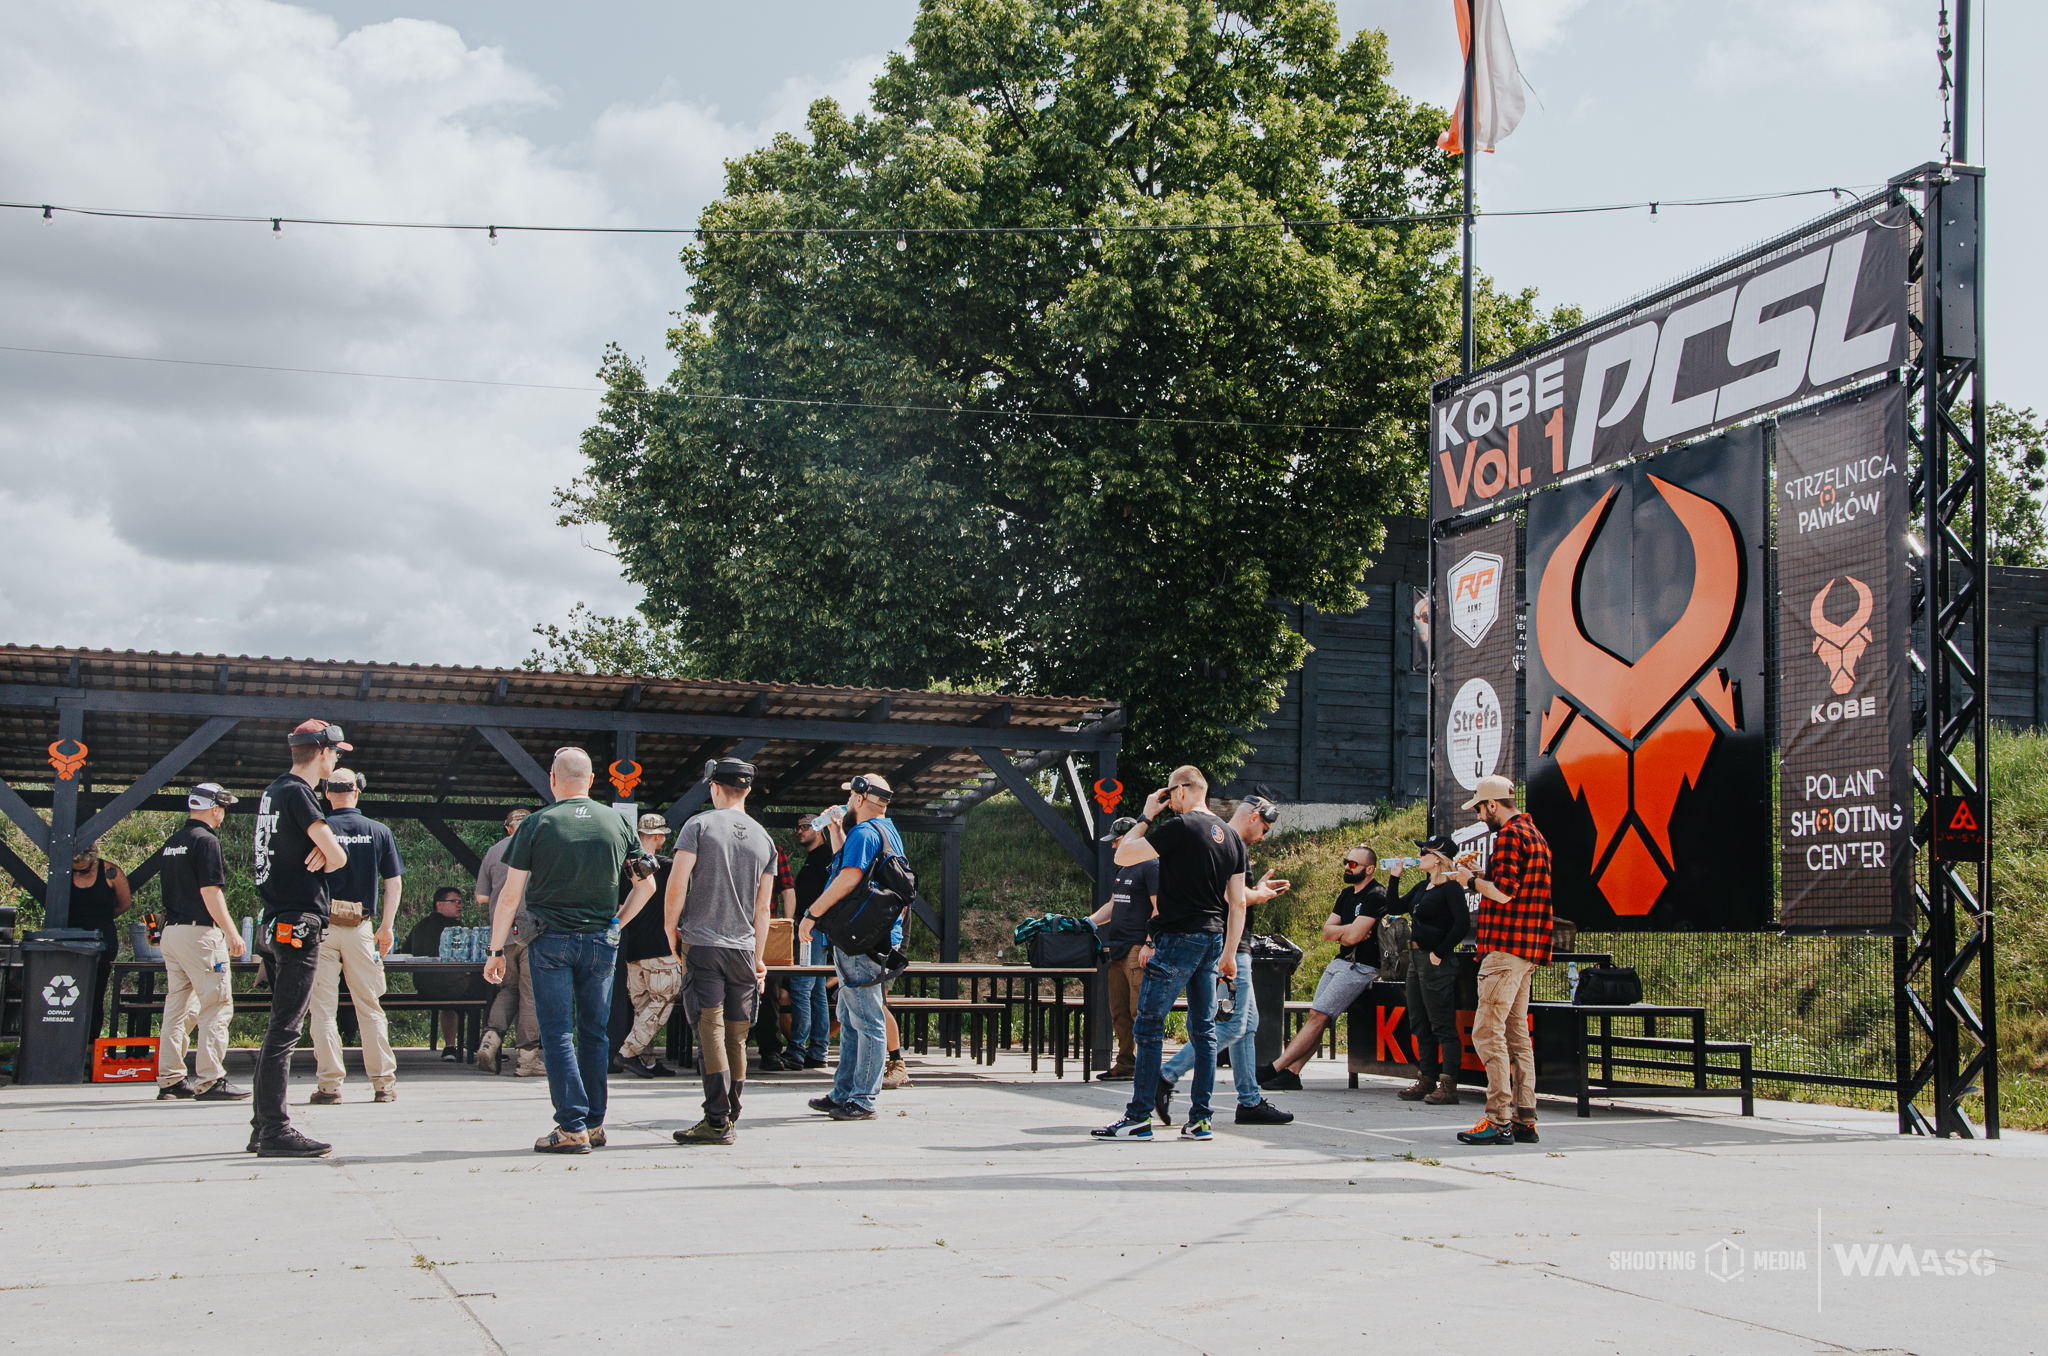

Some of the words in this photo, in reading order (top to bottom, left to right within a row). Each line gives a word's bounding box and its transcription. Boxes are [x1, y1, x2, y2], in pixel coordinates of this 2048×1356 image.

[1568, 229, 1897, 471] PCSL
[1438, 358, 1565, 452] KOBE
[1439, 424, 1532, 508] Vol.
[1544, 406, 1564, 475] 1
[1784, 454, 1898, 501] STRZELNICA
[1798, 491, 1881, 535] PAWŁÓW
[1454, 567, 1496, 604] RP
[1453, 704, 1498, 734] Strefa
[1810, 696, 1876, 724] KOBE
[1805, 768, 1885, 801] POLAND
[1790, 803, 1904, 837] SHOOTING
[333, 834, 373, 846] impoint
[1806, 841, 1886, 871] CENTER
